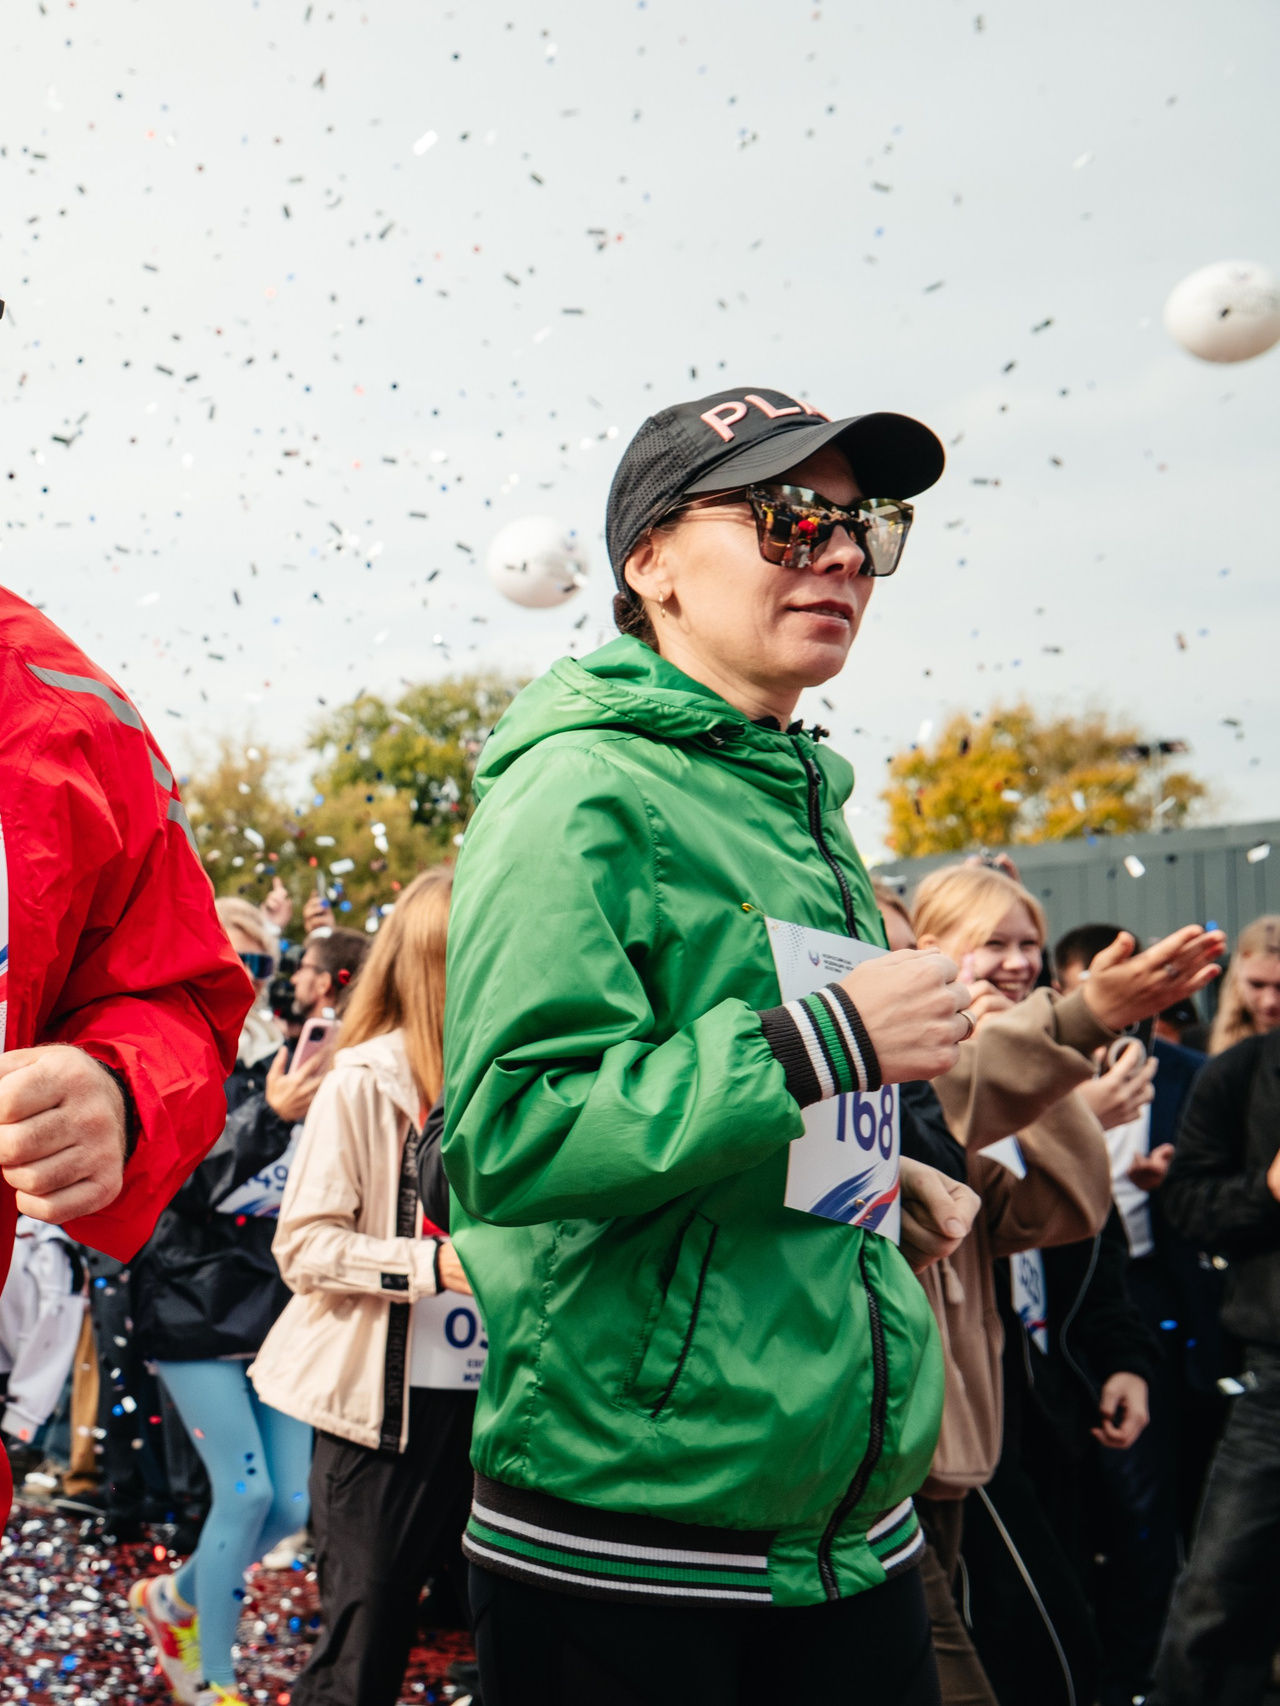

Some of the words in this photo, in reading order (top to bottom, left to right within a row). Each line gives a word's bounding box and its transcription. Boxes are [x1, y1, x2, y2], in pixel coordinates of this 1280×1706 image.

[836, 1084, 894, 1161] 168
[243, 1165, 289, 1192] 49
[444, 1306, 489, 1350] 0
